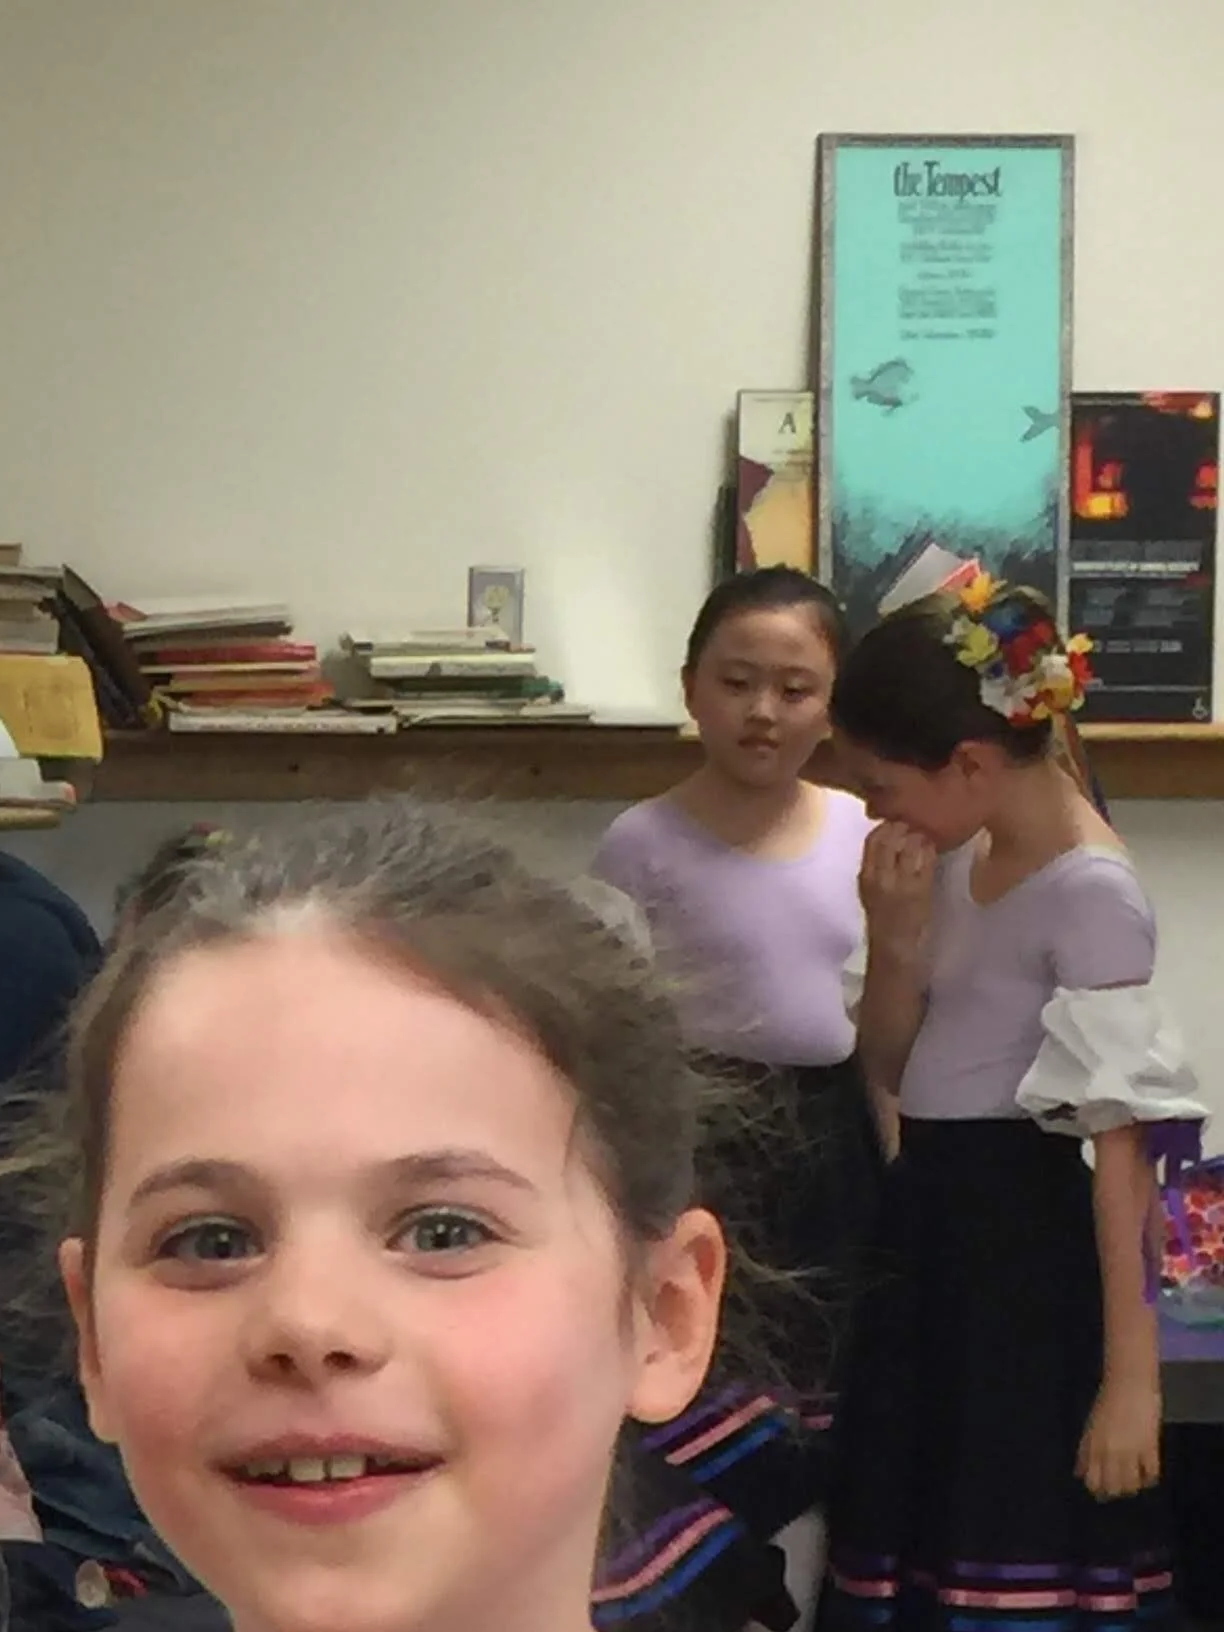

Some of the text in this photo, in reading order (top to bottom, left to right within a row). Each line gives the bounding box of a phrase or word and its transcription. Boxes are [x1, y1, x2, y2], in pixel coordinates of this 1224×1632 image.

[893, 160, 1002, 204] the Tempest
[778, 412, 796, 433] A
